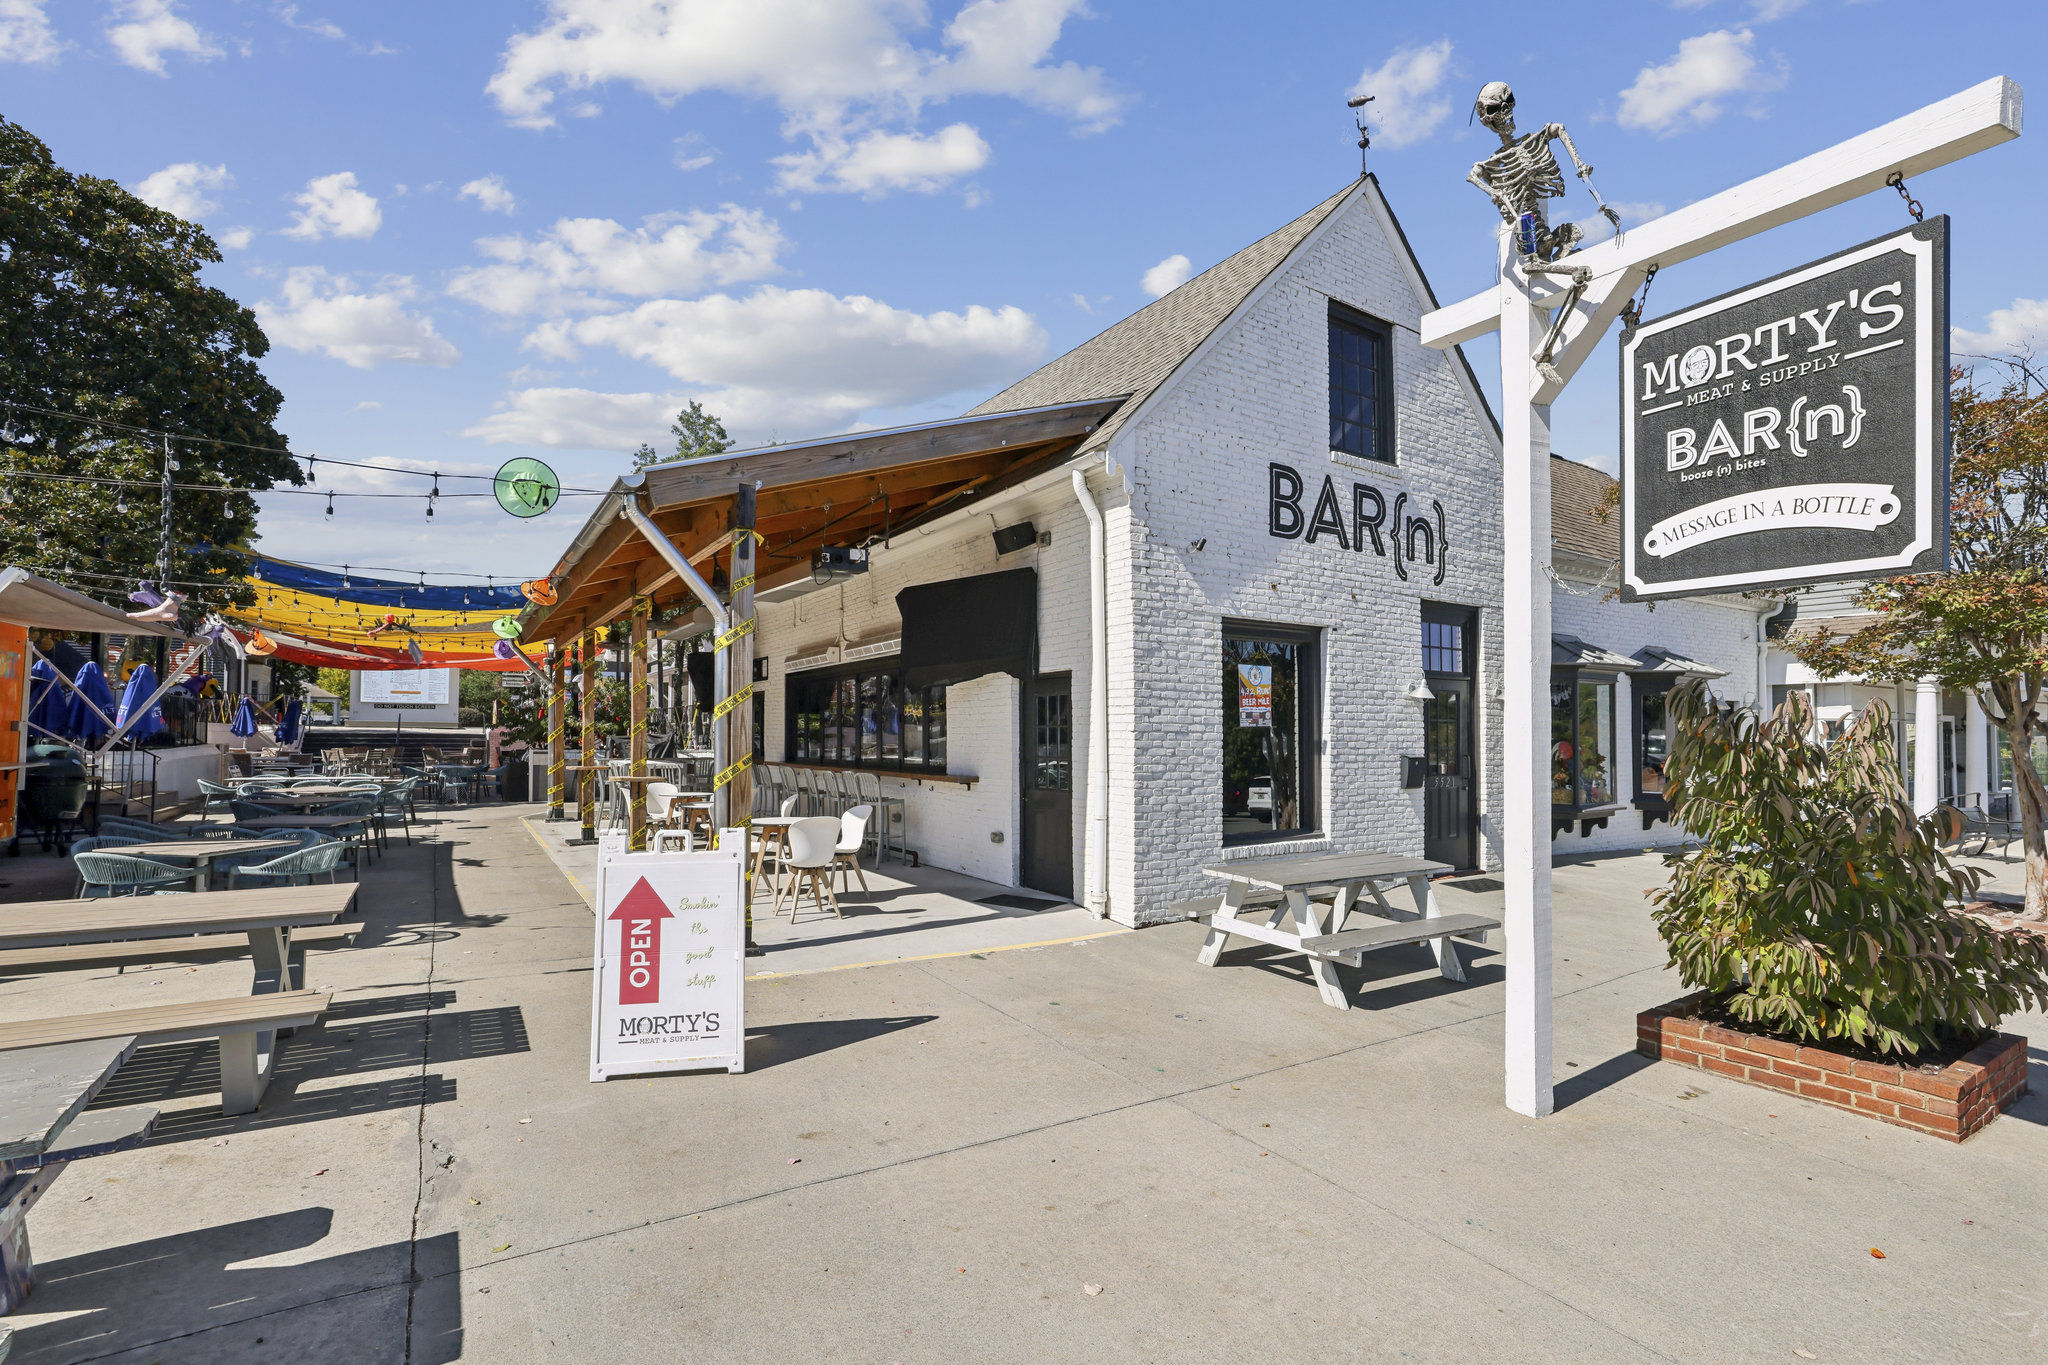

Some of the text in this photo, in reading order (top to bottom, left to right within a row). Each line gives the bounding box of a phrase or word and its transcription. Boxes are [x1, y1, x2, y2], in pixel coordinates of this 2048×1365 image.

[1641, 281, 1904, 401] MORTY'S
[1686, 352, 1841, 407] MEAT & SUPPLY
[1667, 385, 1867, 472] BAR{n}
[1680, 458, 1767, 483] booze {n} bites
[1269, 462, 1449, 587] BAR{n}
[1661, 496, 1876, 546] MESSAGE IN A BOTTLE
[1241, 696, 1270, 707] BEER MILE
[629, 918, 652, 989] OPEN
[685, 945, 715, 965] good
[686, 972, 717, 989] stuff
[618, 1011, 720, 1037] MORTY'S
[639, 1037, 661, 1045] MEAT
[669, 1035, 700, 1043] SUPPLY
